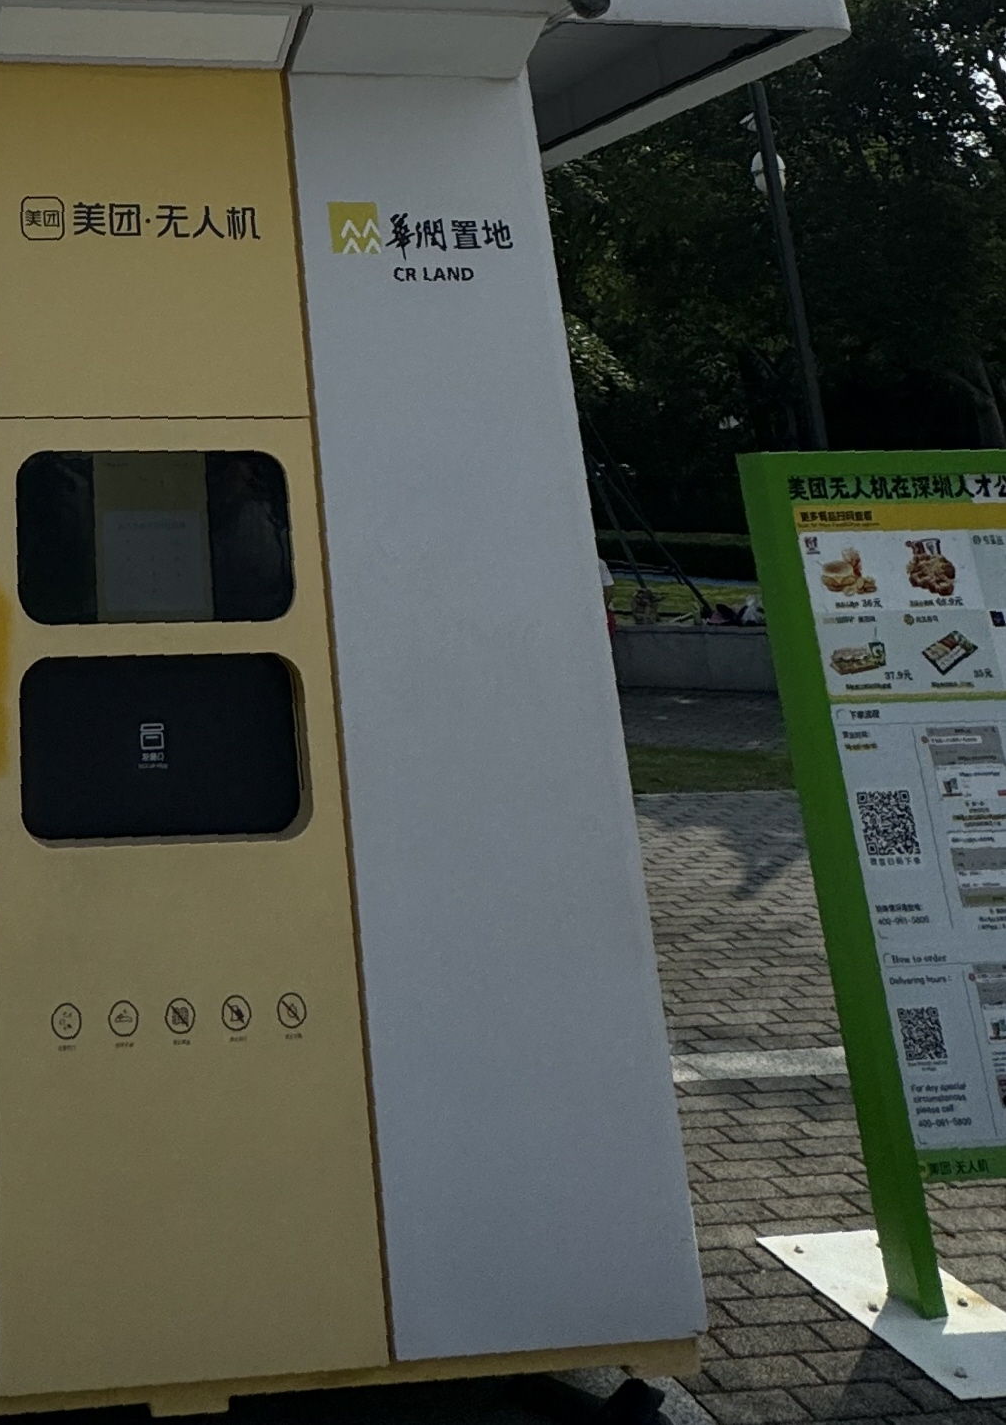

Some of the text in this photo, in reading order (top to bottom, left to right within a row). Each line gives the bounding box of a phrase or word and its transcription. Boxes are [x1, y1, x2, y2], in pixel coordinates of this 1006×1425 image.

[25, 208, 60, 228] 美团
[394, 266, 474, 282] CR LAND
[912, 954, 922, 963] to
[924, 953, 947, 963] order
